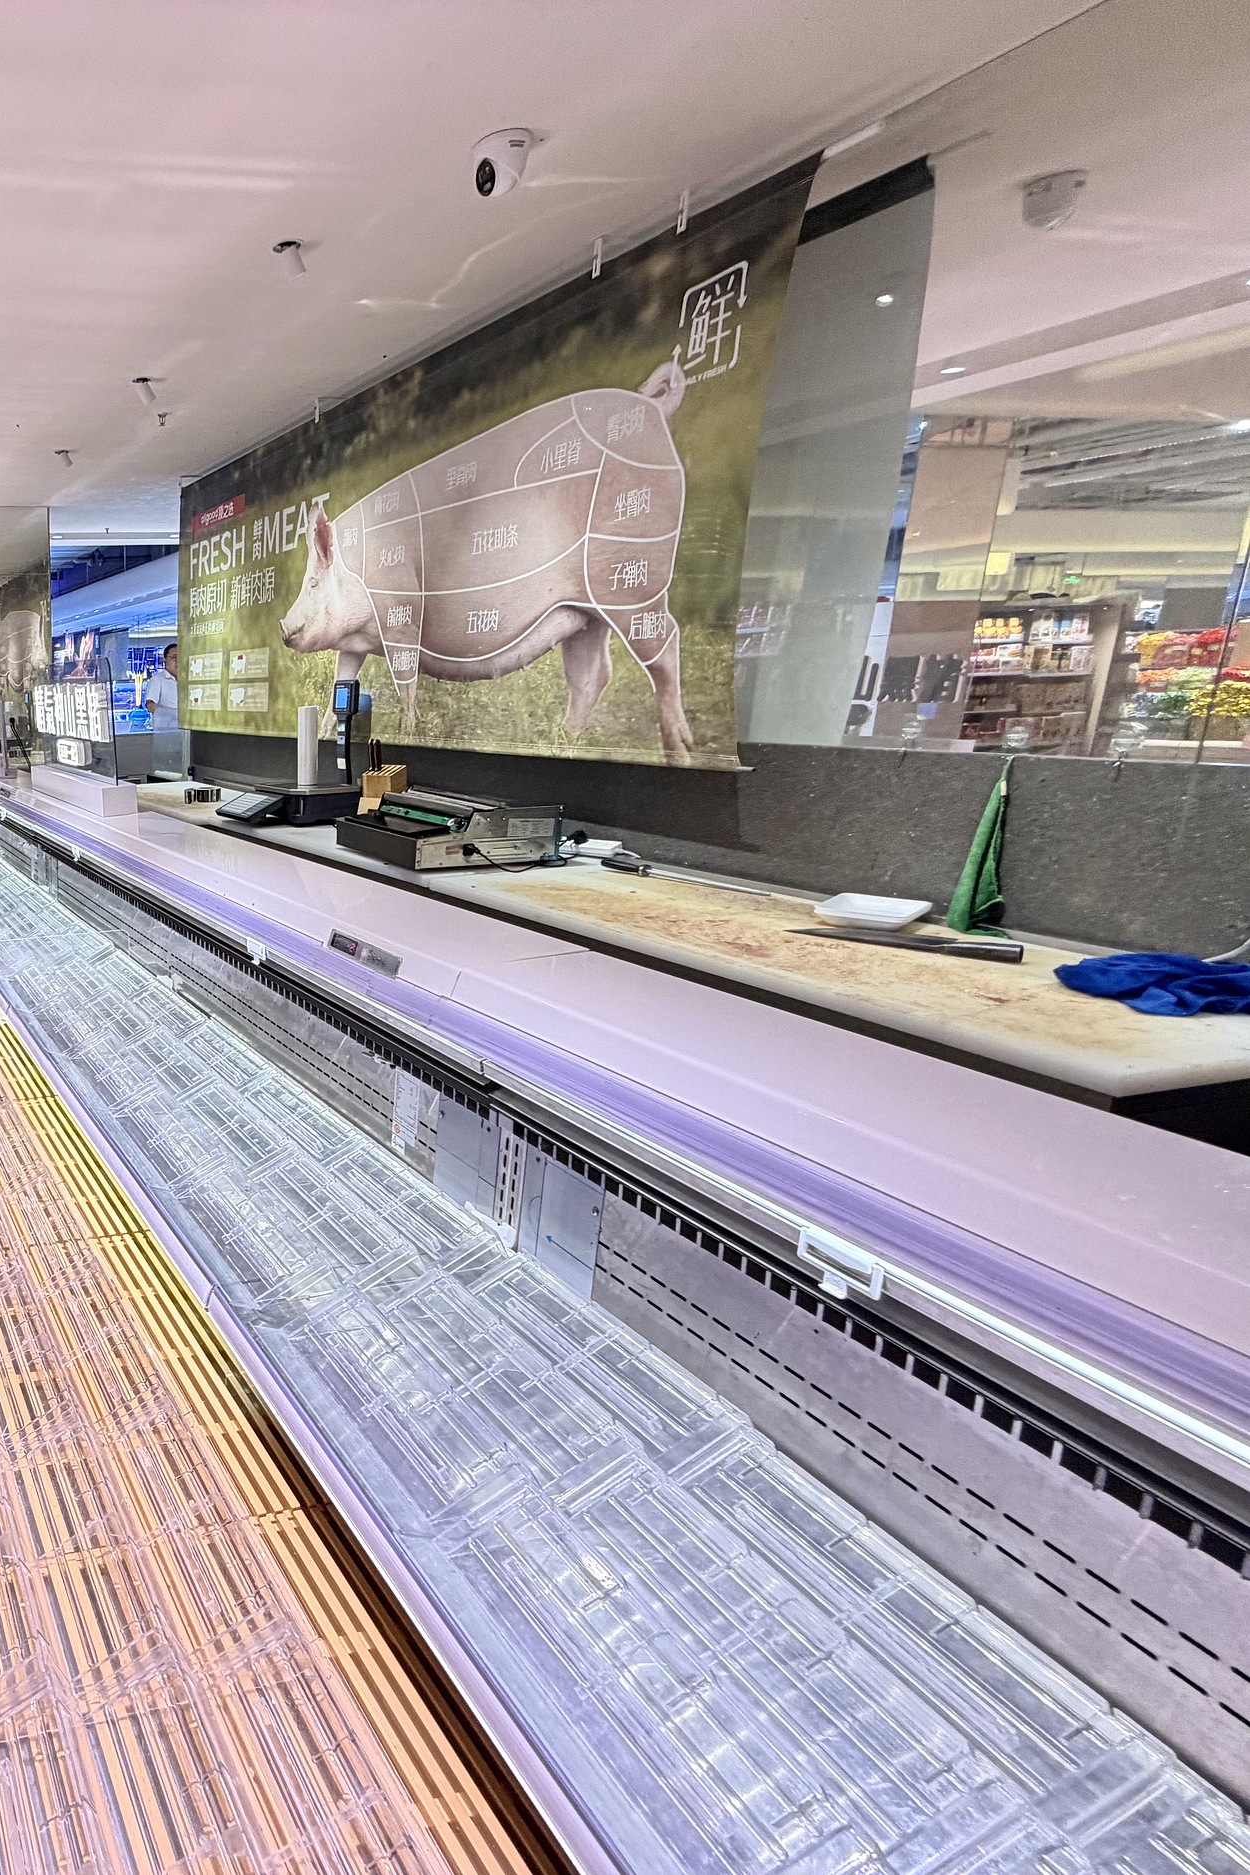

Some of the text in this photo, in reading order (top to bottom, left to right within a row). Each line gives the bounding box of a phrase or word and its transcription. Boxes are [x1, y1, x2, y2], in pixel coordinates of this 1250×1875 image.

[683, 274, 735, 371] 鲜
[540, 437, 582, 473] 小里脊
[614, 486, 651, 521] 坐臀肉
[190, 491, 330, 581] FRESH MEAT
[378, 544, 405, 569] 夹心肉
[609, 558, 648, 590] 子弹肉
[190, 566, 275, 618] 原肉原切 新鲜肉源
[387, 604, 412, 627] 前排肉
[466, 607, 499, 634] 五花肉
[628, 610, 666, 640] 后腿肉
[393, 650, 417, 671] 前腿肉
